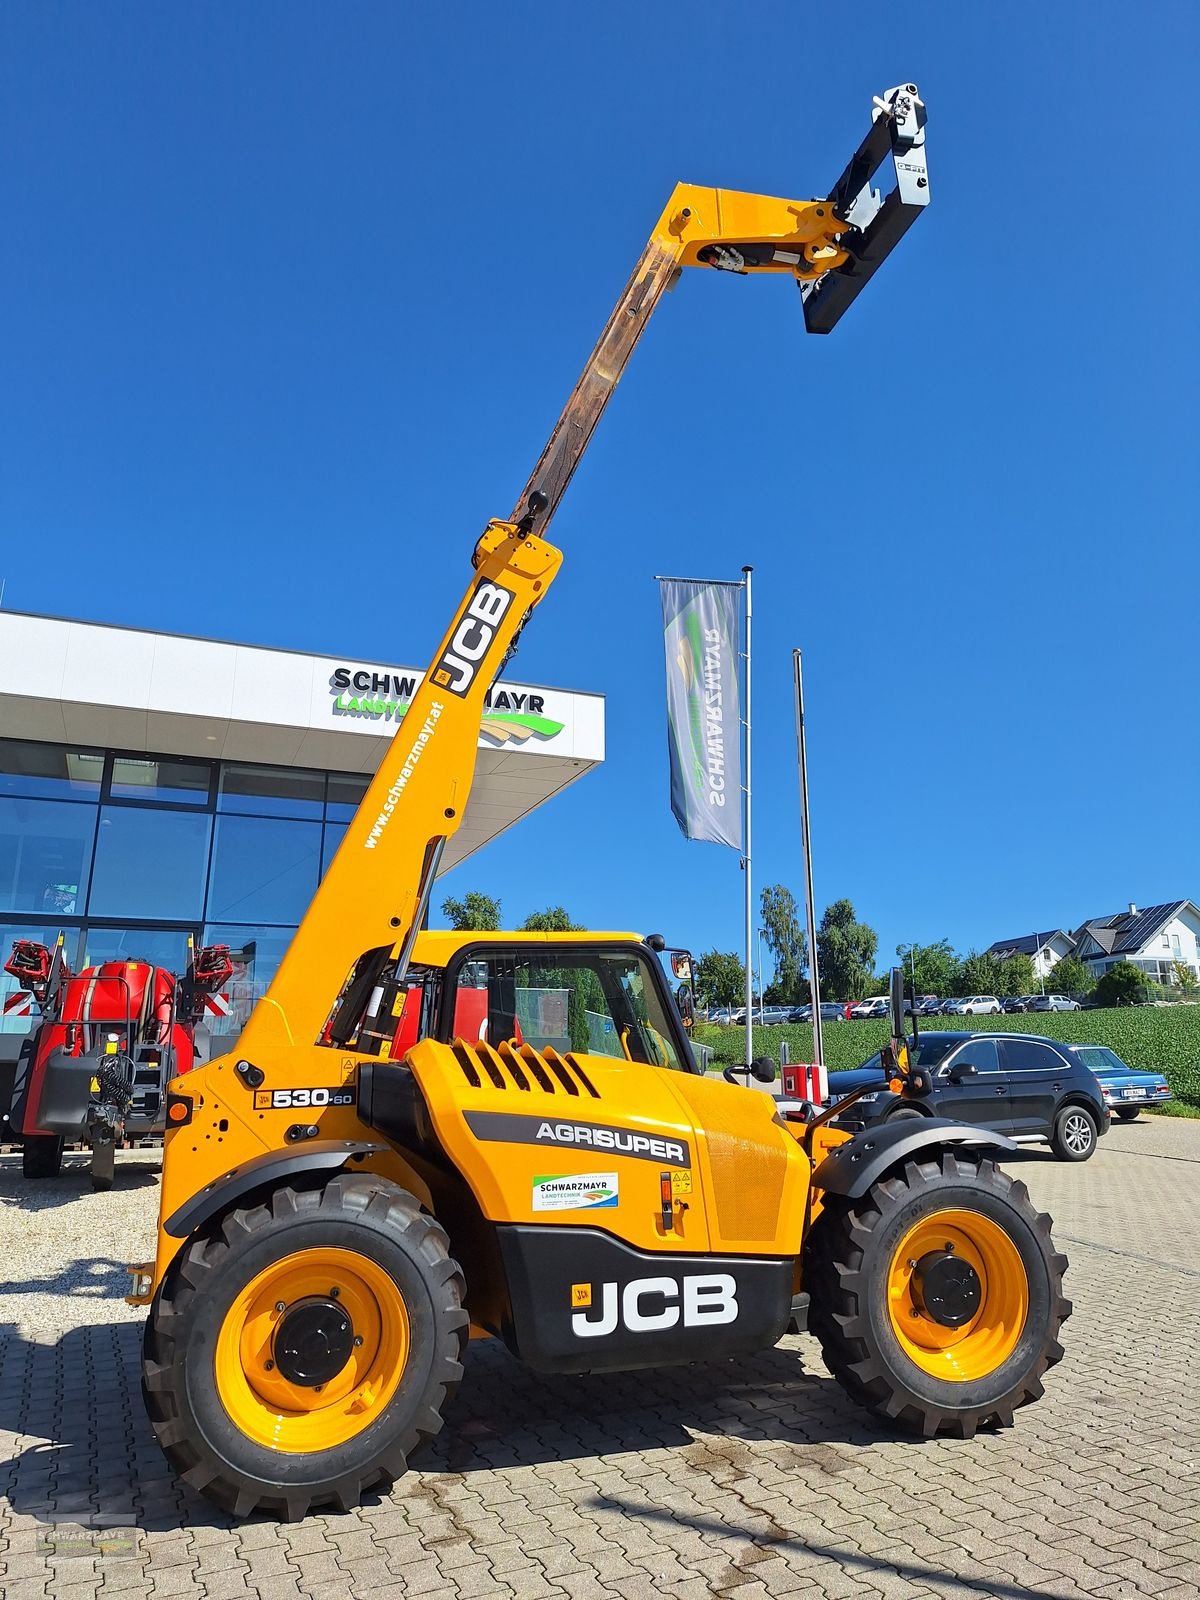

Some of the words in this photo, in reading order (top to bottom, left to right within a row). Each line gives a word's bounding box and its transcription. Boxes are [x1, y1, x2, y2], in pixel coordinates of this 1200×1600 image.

[443, 583, 511, 693] JCB
[334, 668, 545, 713] SCHWAYR
[364, 701, 445, 849] www.schwarzmayr.at
[536, 1122, 684, 1162] AGRISUPER
[540, 1182, 607, 1192] SCHWARZMAYR
[572, 1274, 739, 1337] JCB
